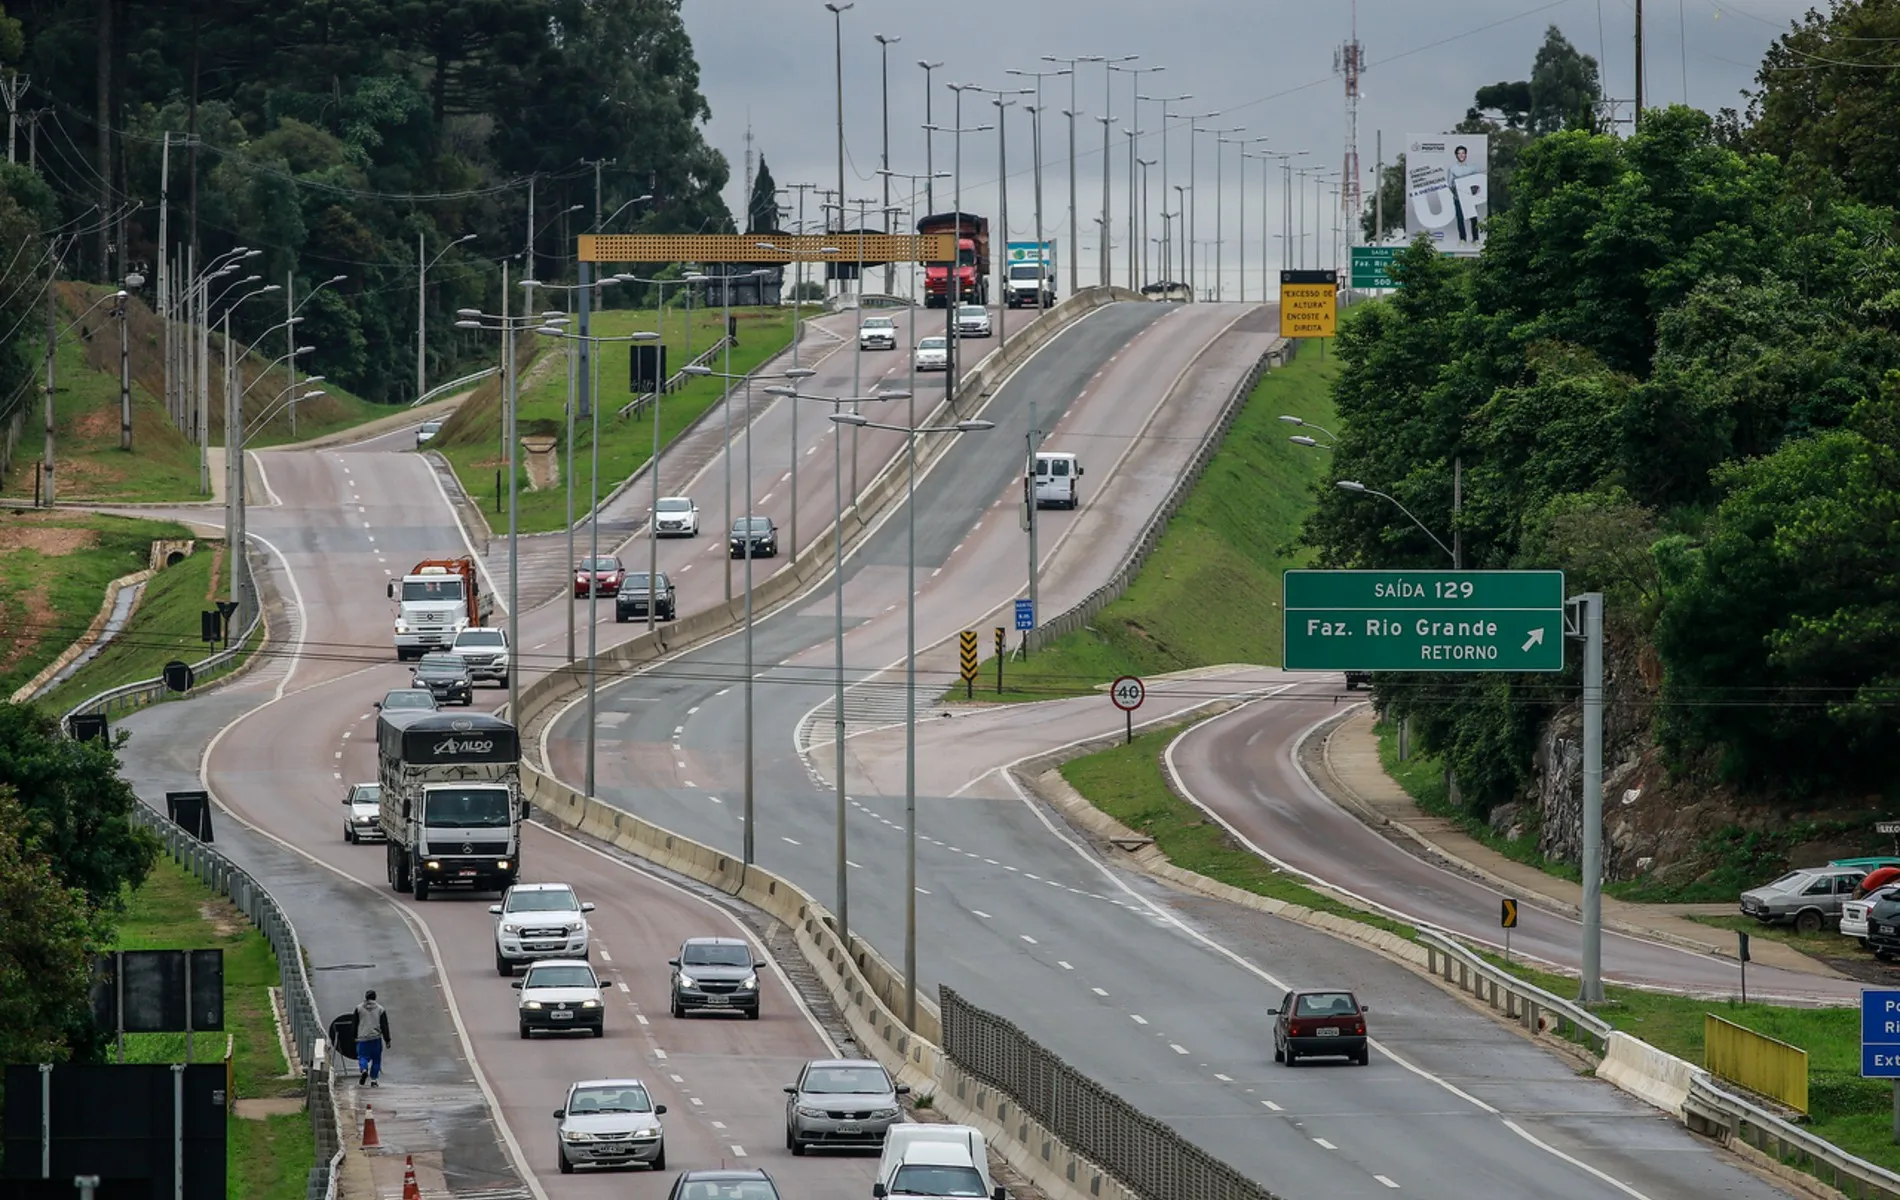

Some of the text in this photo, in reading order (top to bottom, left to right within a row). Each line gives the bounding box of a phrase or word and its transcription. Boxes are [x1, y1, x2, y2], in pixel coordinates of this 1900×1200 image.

[1374, 578, 1474, 599] SAÍDA 129
[1307, 619, 1498, 637] Faz. Rio Grande
[1421, 645, 1498, 660] RETORNO
[1118, 685, 1140, 699] 40
